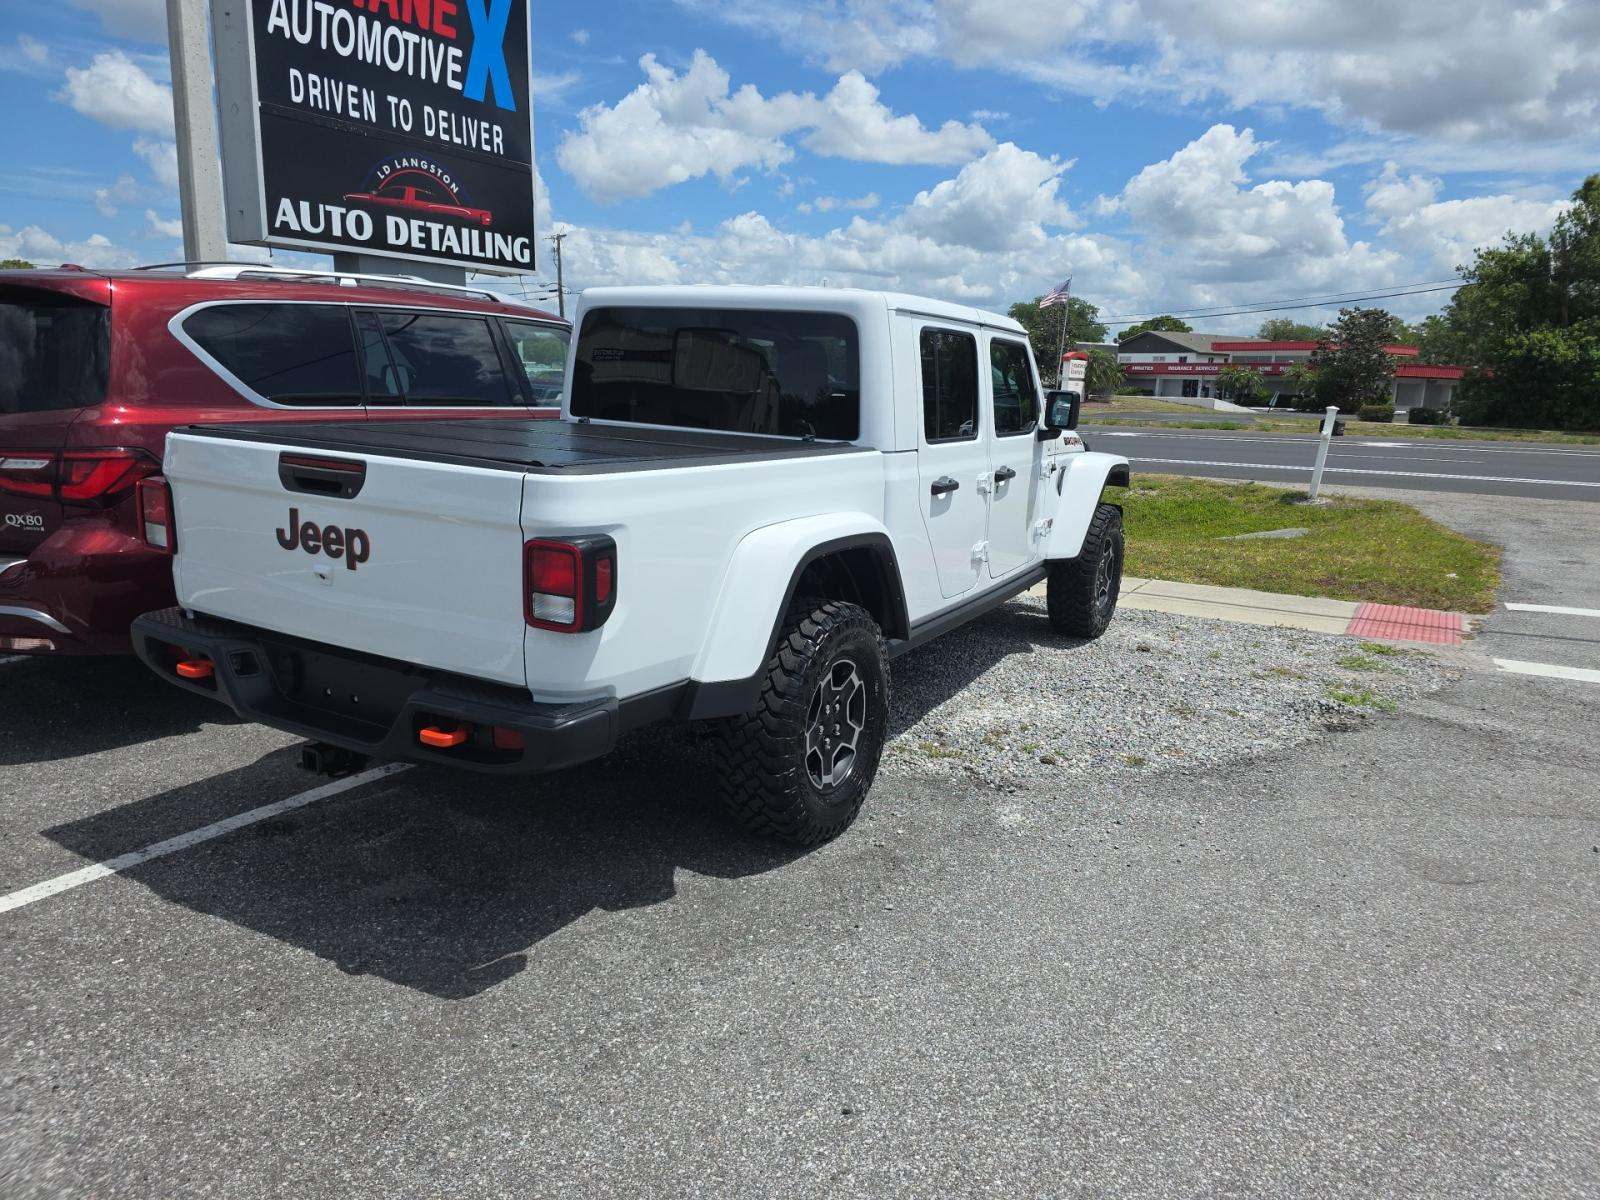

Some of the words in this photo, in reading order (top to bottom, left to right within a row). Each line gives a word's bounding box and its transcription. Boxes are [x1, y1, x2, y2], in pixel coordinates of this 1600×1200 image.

[267, 0, 464, 91] AUTOMOTIVE
[463, 0, 517, 112] X
[289, 68, 376, 122] DRIVEN
[387, 95, 413, 132] TO
[424, 105, 504, 155] DELIVER
[377, 165, 391, 179] LD
[395, 158, 459, 194] LANGSTON
[274, 197, 373, 241] AUTO
[386, 215, 531, 263] DETAILING
[5, 514, 43, 527] QX80
[275, 507, 370, 571] Jeep
